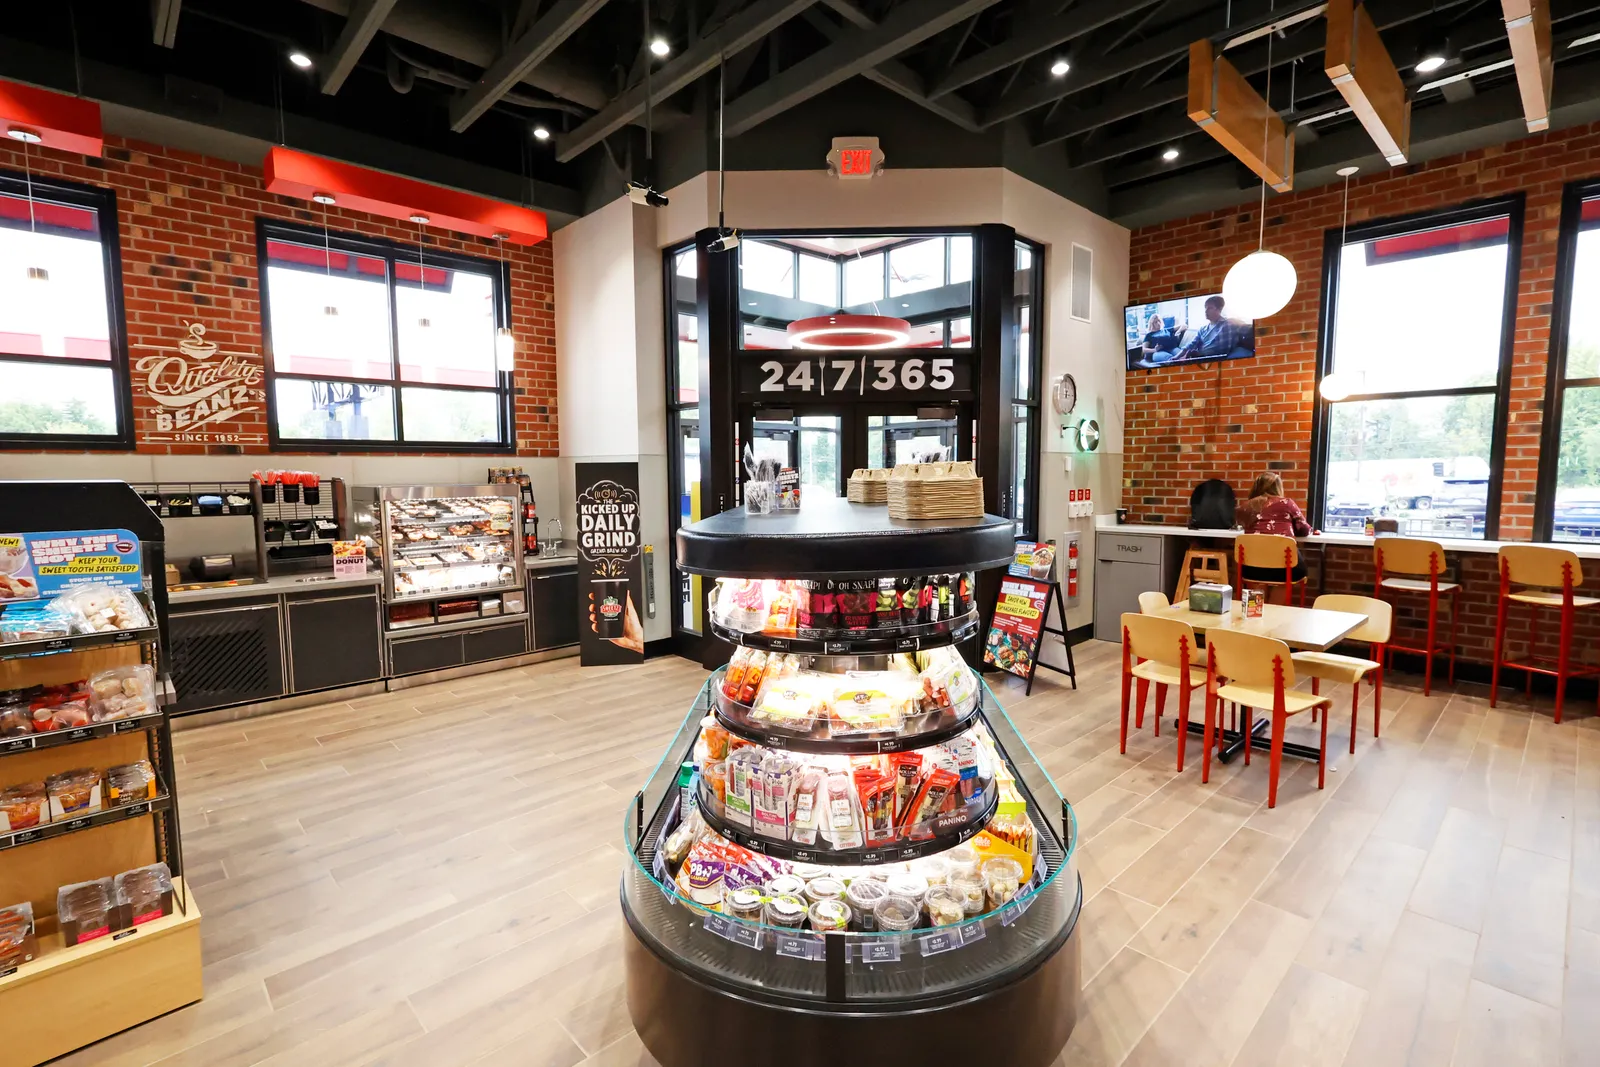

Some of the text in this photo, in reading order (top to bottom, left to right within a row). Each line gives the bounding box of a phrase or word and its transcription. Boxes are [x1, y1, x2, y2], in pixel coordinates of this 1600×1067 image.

[841, 149, 873, 175] EXIT
[134, 355, 262, 394] Quality
[759, 358, 956, 392] 24 7 365
[156, 385, 250, 432] BEANZ
[174, 434, 240, 442] SINCE 1952
[581, 503, 636, 515] KICKED UP
[581, 513, 636, 532] DAILY
[30, 534, 119, 549] WHY THE
[581, 531, 637, 549] GRIND
[31, 544, 108, 558] SHEETZ
[1117, 544, 1143, 553] TRASH
[34, 554, 76, 565] NOT
[78, 556, 119, 565] KEEP YOUR
[335, 557, 365, 566] DONUT
[41, 564, 137, 574] SWEET TOOTH SATISFIED?
[938, 815, 967, 828] PANINO
